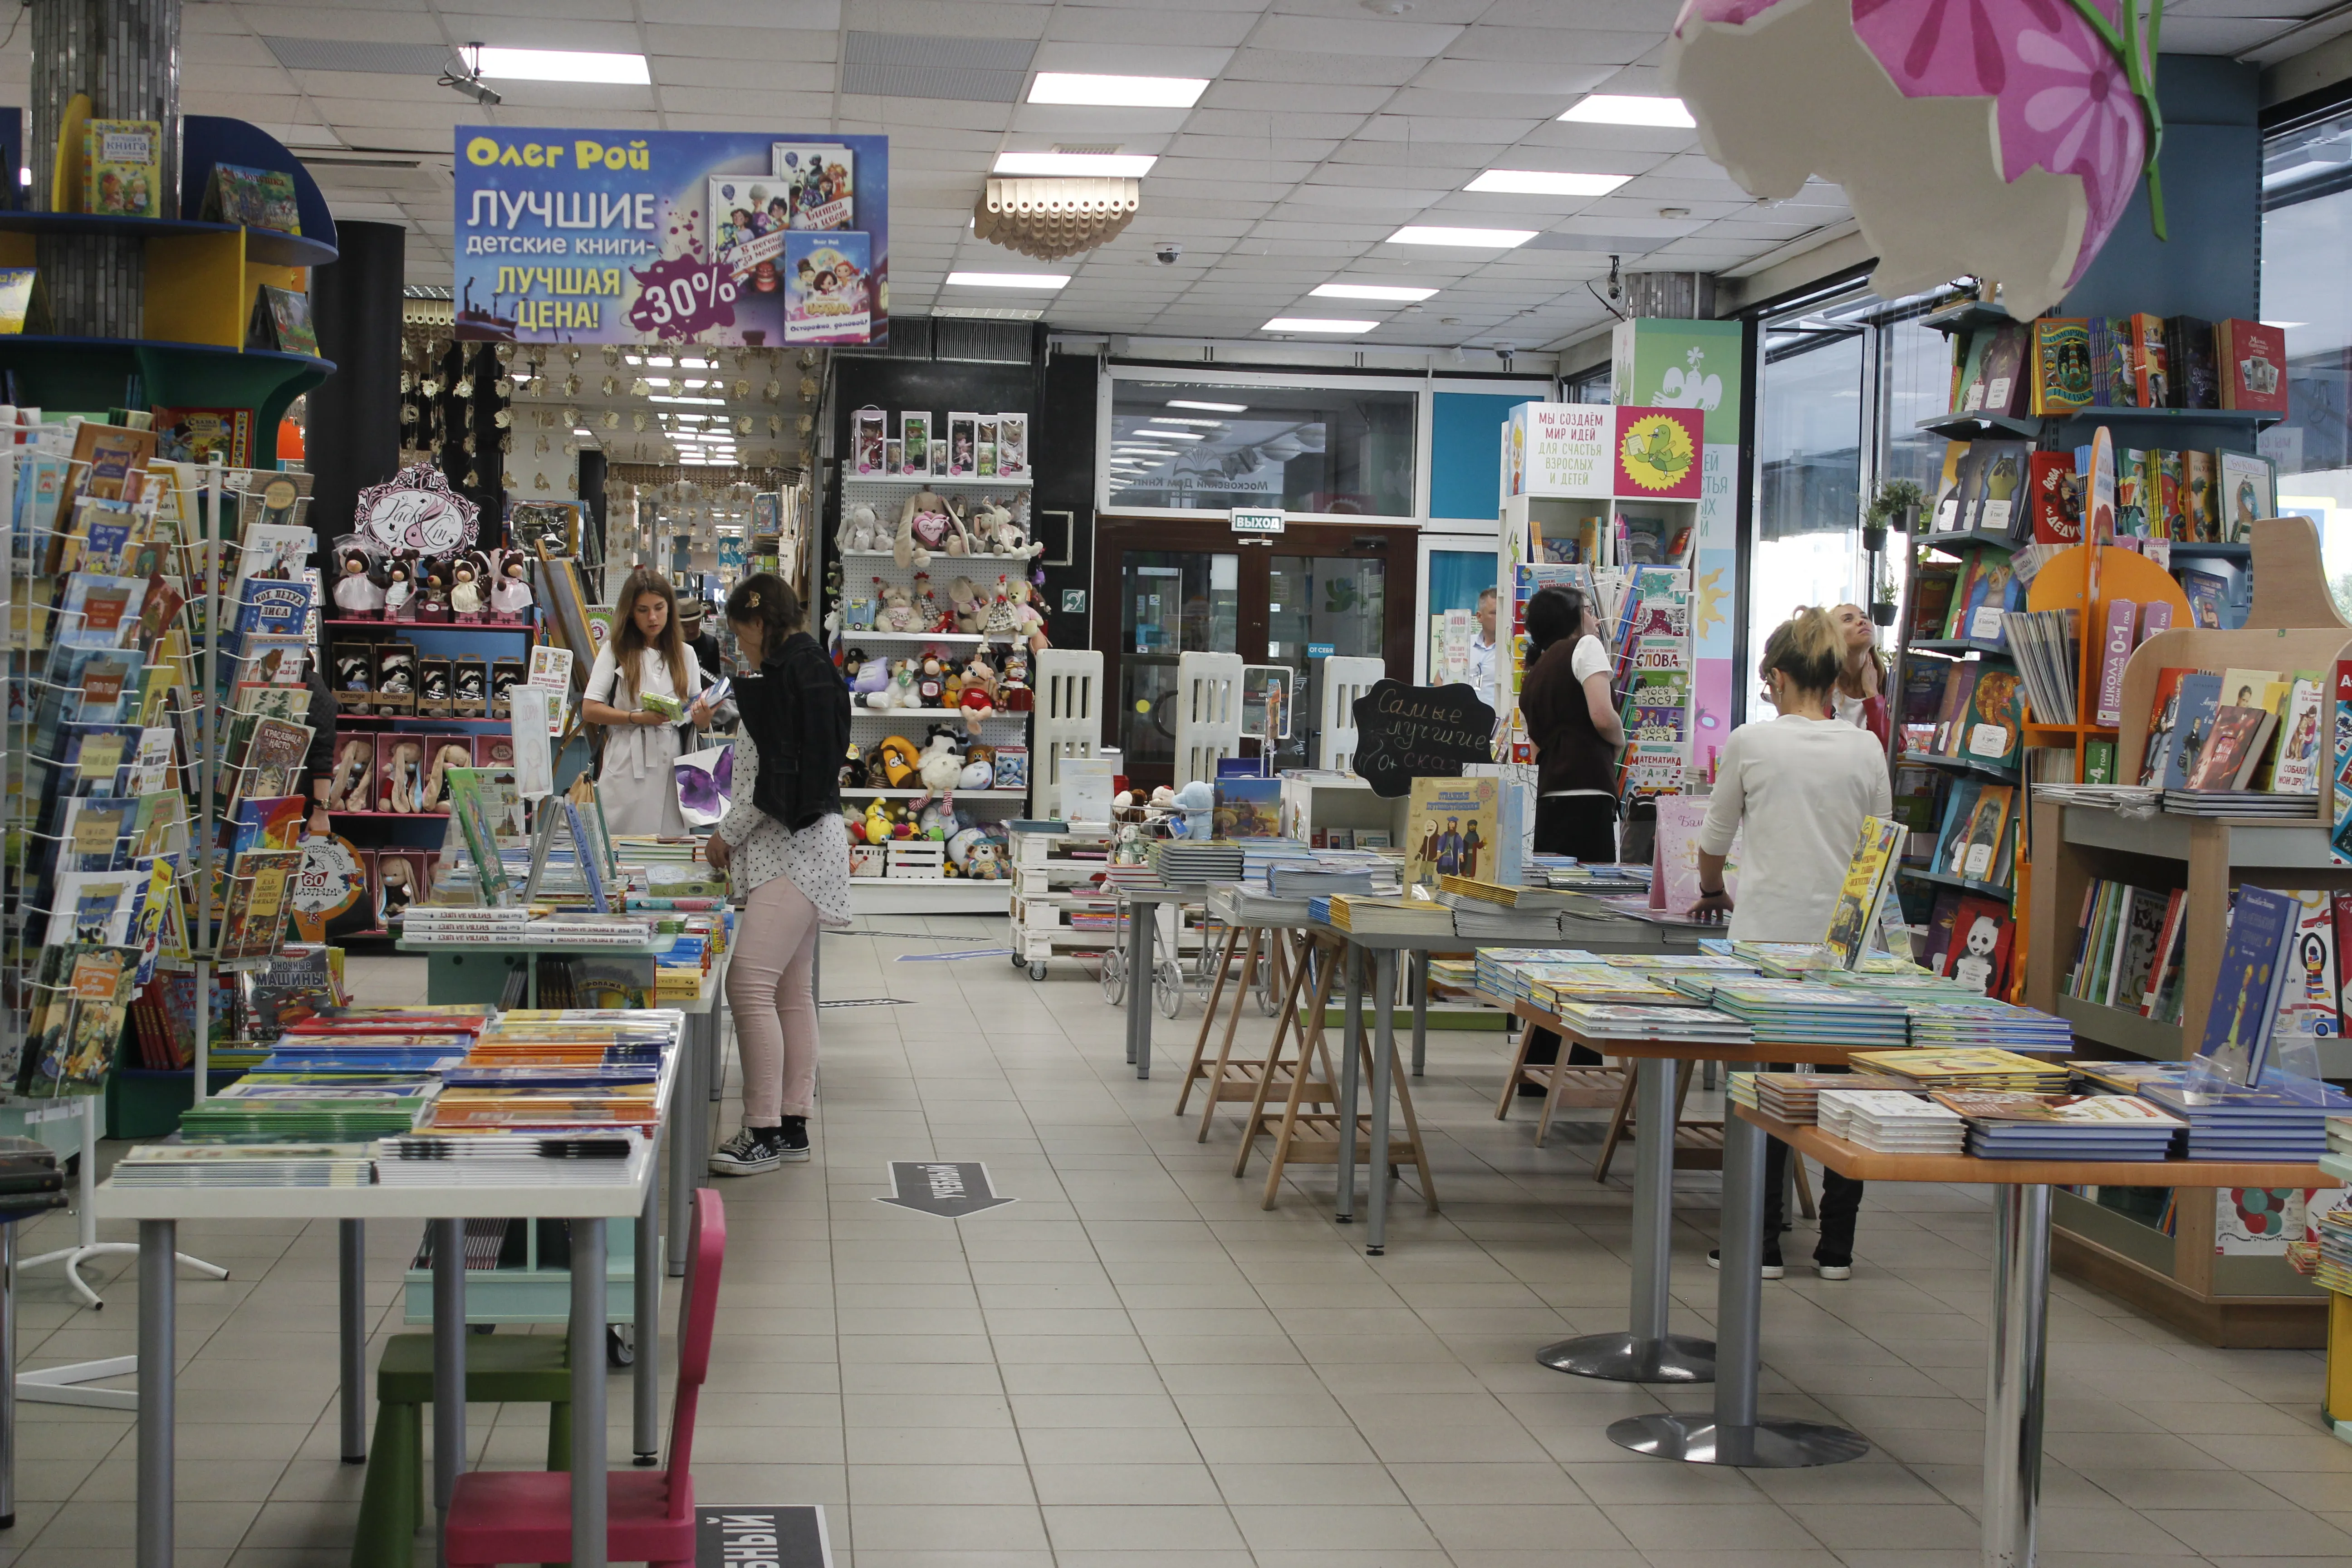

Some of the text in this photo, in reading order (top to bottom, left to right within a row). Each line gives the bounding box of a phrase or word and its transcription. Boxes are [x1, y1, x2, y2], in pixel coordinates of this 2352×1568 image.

[107, 142, 147, 151] книга
[466, 137, 649, 171] Олег Рой
[466, 189, 656, 230] ЛУЧШИЕ
[466, 236, 566, 255] детские
[495, 266, 619, 295] ЛУЧШАЯ
[634, 269, 735, 323] -30%
[518, 301, 598, 329] ЦЕНА!
[1539, 412, 1555, 425] МЫ
[1545, 427, 1595, 441] МИР ИДЕЙ
[1539, 442, 1602, 456] ДЛЯ СЧАСТЬЯ
[1545, 458, 1593, 471] ВЗРОСЛЫХ
[2231, 459, 2260, 472] БУКВЫ
[1550, 472, 1588, 485] И ДЕТЕЙ
[2043, 467, 2063, 490] ВОВА,
[1236, 516, 1280, 529] ВЫХОД
[275, 590, 303, 606] ПЕТУХ
[262, 607, 289, 616] ЛИСА
[586, 607, 612, 616] КИДКА
[1637, 653, 1679, 667] СЛОВА
[2104, 657, 2120, 707] ШКОЛА
[1378, 689, 1462, 724] Самые
[264, 727, 303, 744] КРАСАВИЦА
[1387, 721, 1487, 751] лучшие
[1403, 753, 1458, 772] сказ
[1630, 755, 1681, 766] МАТЕМАТИКА
[2283, 764, 2307, 774] СОБАКИ
[302, 844, 345, 871] ТЕЛЬСТВО
[303, 874, 325, 887] 60
[271, 960, 312, 971] оночные
[255, 972, 325, 987] МАШИНЫ
[917, 1165, 967, 1199] УЧЕБНЫЙ
